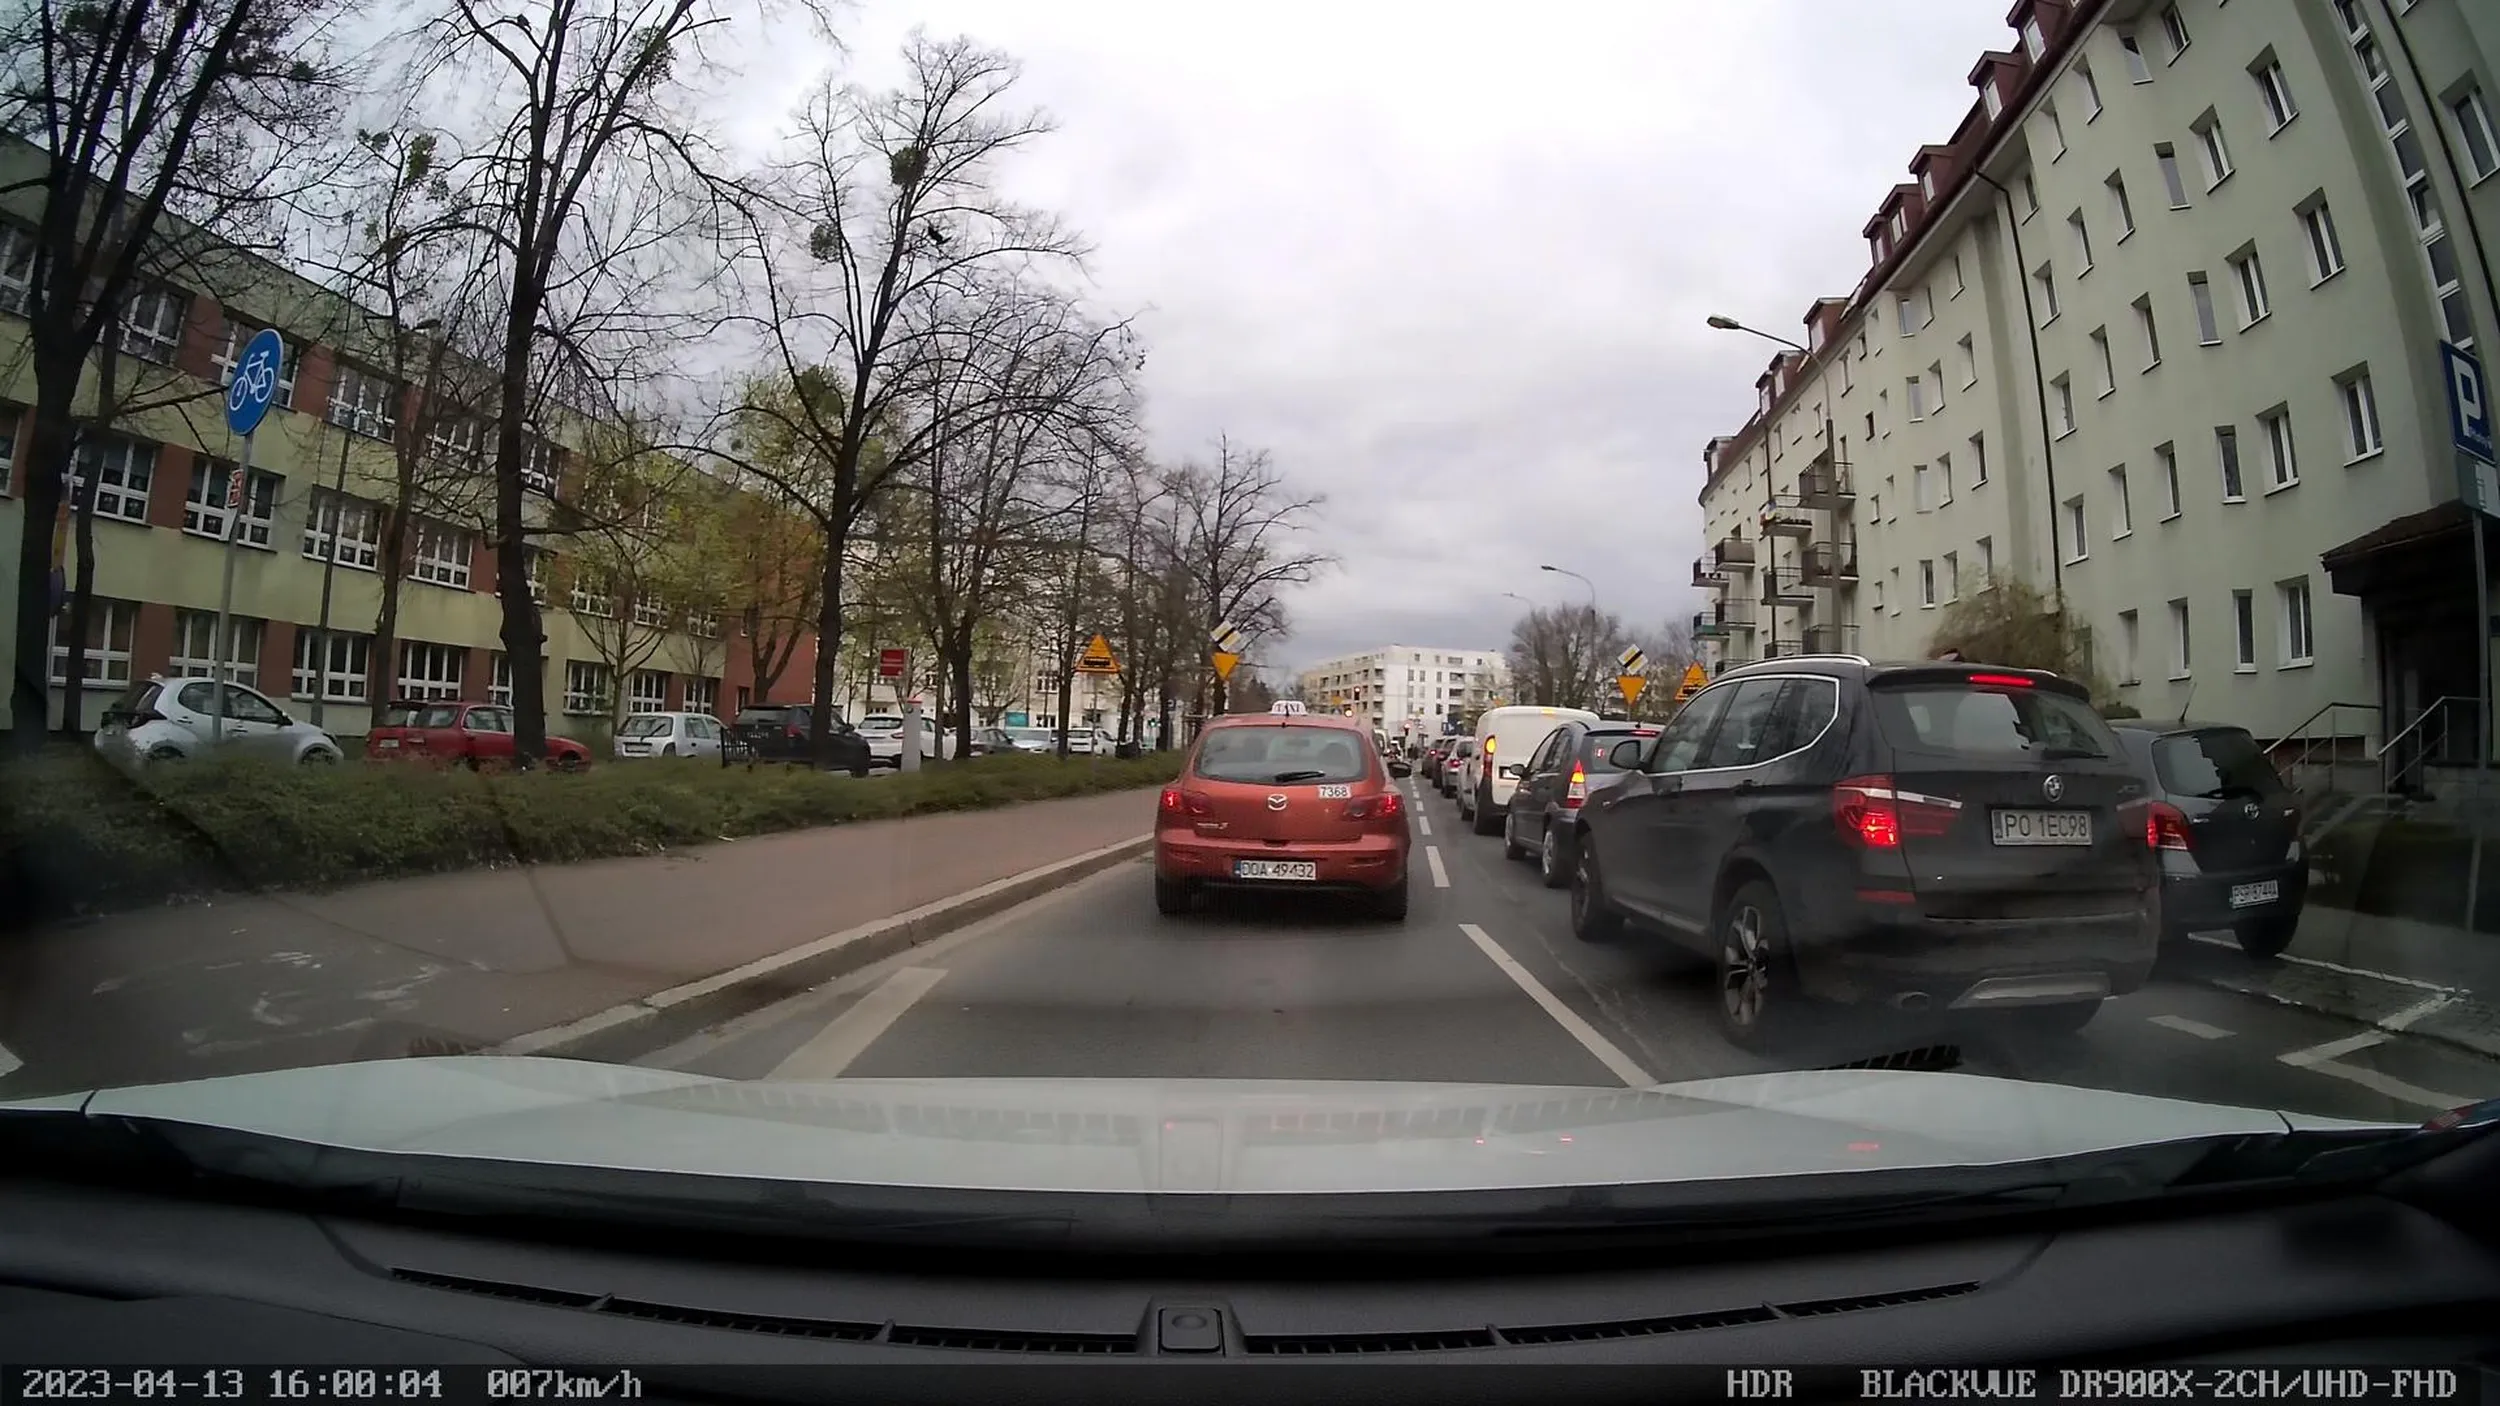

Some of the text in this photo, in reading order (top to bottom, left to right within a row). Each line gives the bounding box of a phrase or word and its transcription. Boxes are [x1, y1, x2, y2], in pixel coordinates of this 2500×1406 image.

[2451, 354, 2481, 436] P
[1320, 786, 1348, 797] 7368
[2004, 814, 2087, 838] PO 1EC98
[1272, 863, 1314, 878] 49432
